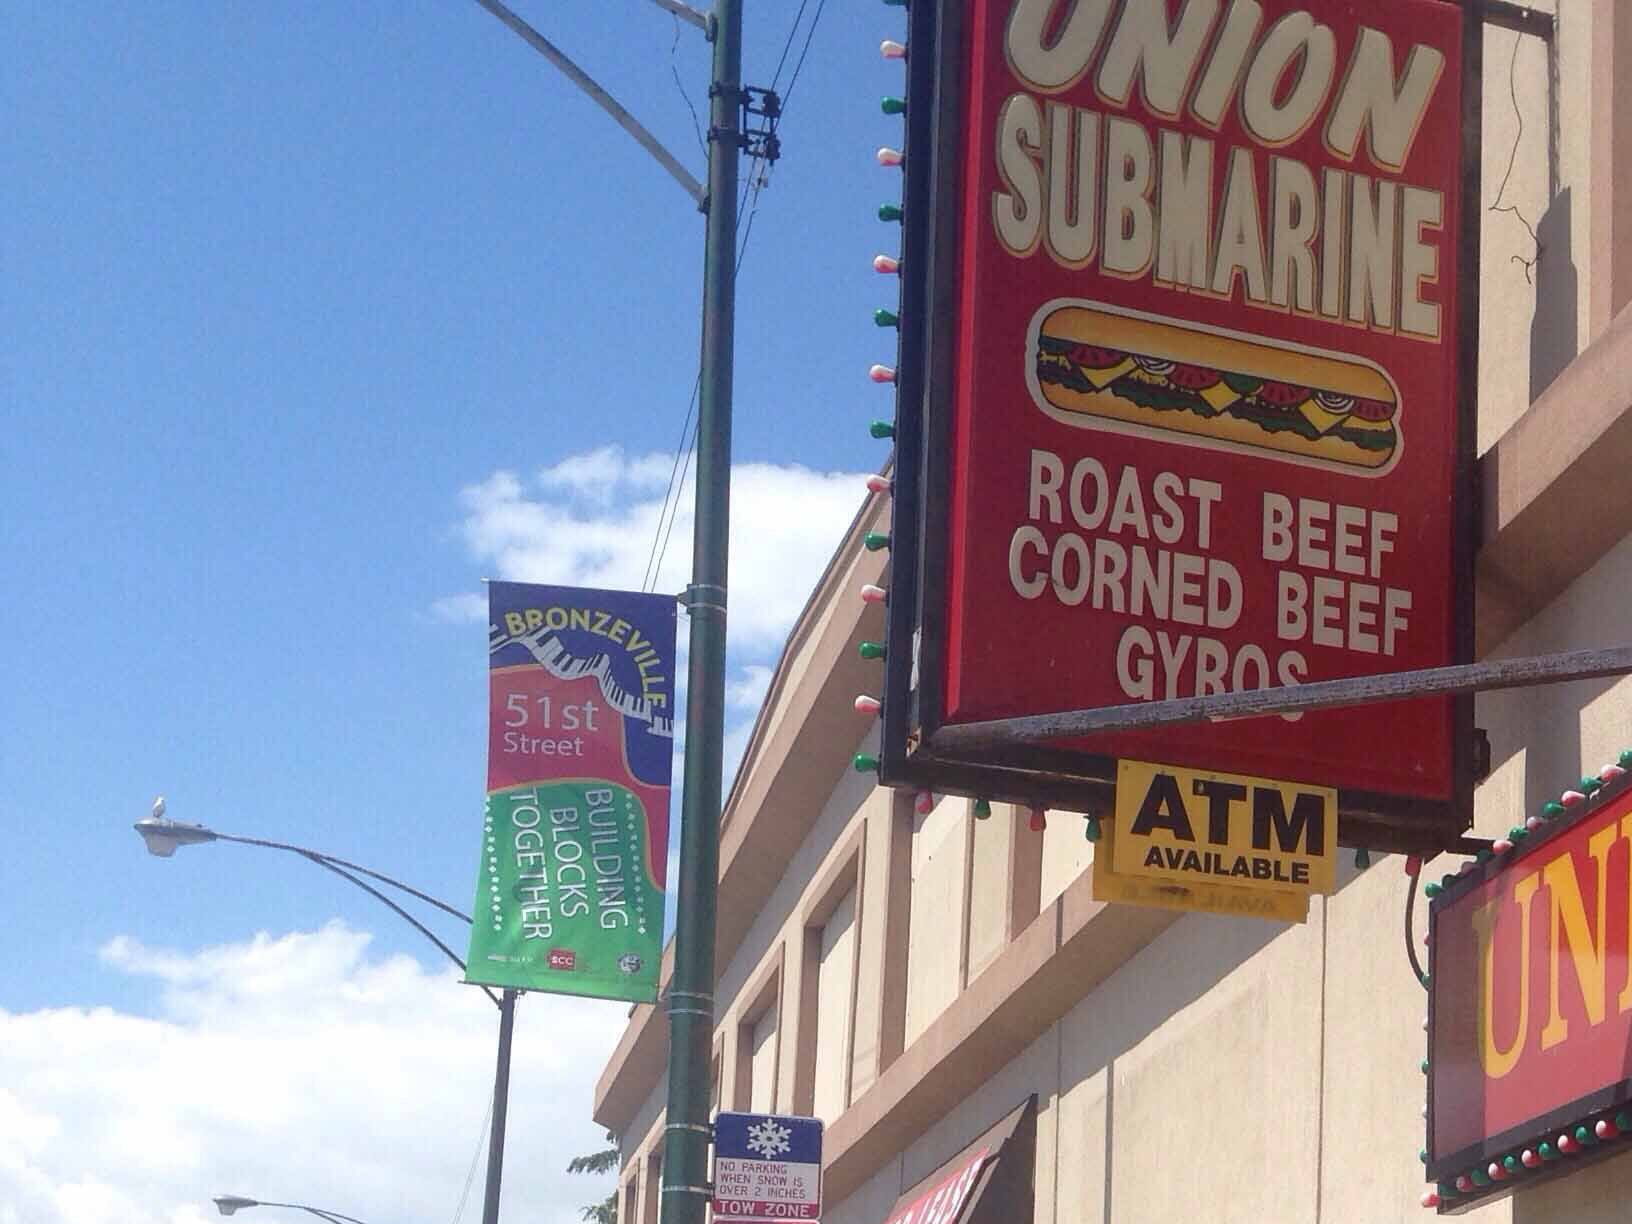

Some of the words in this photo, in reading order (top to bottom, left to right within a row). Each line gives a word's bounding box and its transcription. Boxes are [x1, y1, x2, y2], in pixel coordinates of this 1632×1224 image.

[1004, 0, 1446, 173] UNION
[993, 94, 1445, 344] SUBMARINE
[1028, 448, 1222, 550] ROAST
[1262, 492, 1399, 579] BEEF
[1008, 526, 1244, 630] CORNED
[1277, 570, 1413, 657] BEEF
[504, 606, 667, 709] BRONZEVILLE
[1116, 624, 1309, 723] GYROS
[503, 733, 585, 758] Street
[504, 693, 600, 733] 51st
[508, 786, 554, 941] TOGETHER
[548, 806, 590, 919] BLOCKS
[584, 788, 629, 930] BUILDING
[1130, 773, 1326, 857] ATM
[1144, 845, 1310, 885] AVAILABLE
[720, 1161, 736, 1171] NO
[742, 1162, 788, 1174] PARKING
[720, 1174, 751, 1183] WHEN
[757, 1175, 788, 1186] SNOW
[794, 1177, 803, 1187] IS
[720, 1185, 748, 1196] OVER
[754, 1187, 761, 1197] 2
[767, 1188, 806, 1199] INCHES
[720, 1200, 756, 1214] TOW
[765, 1203, 811, 1217] ZONE
